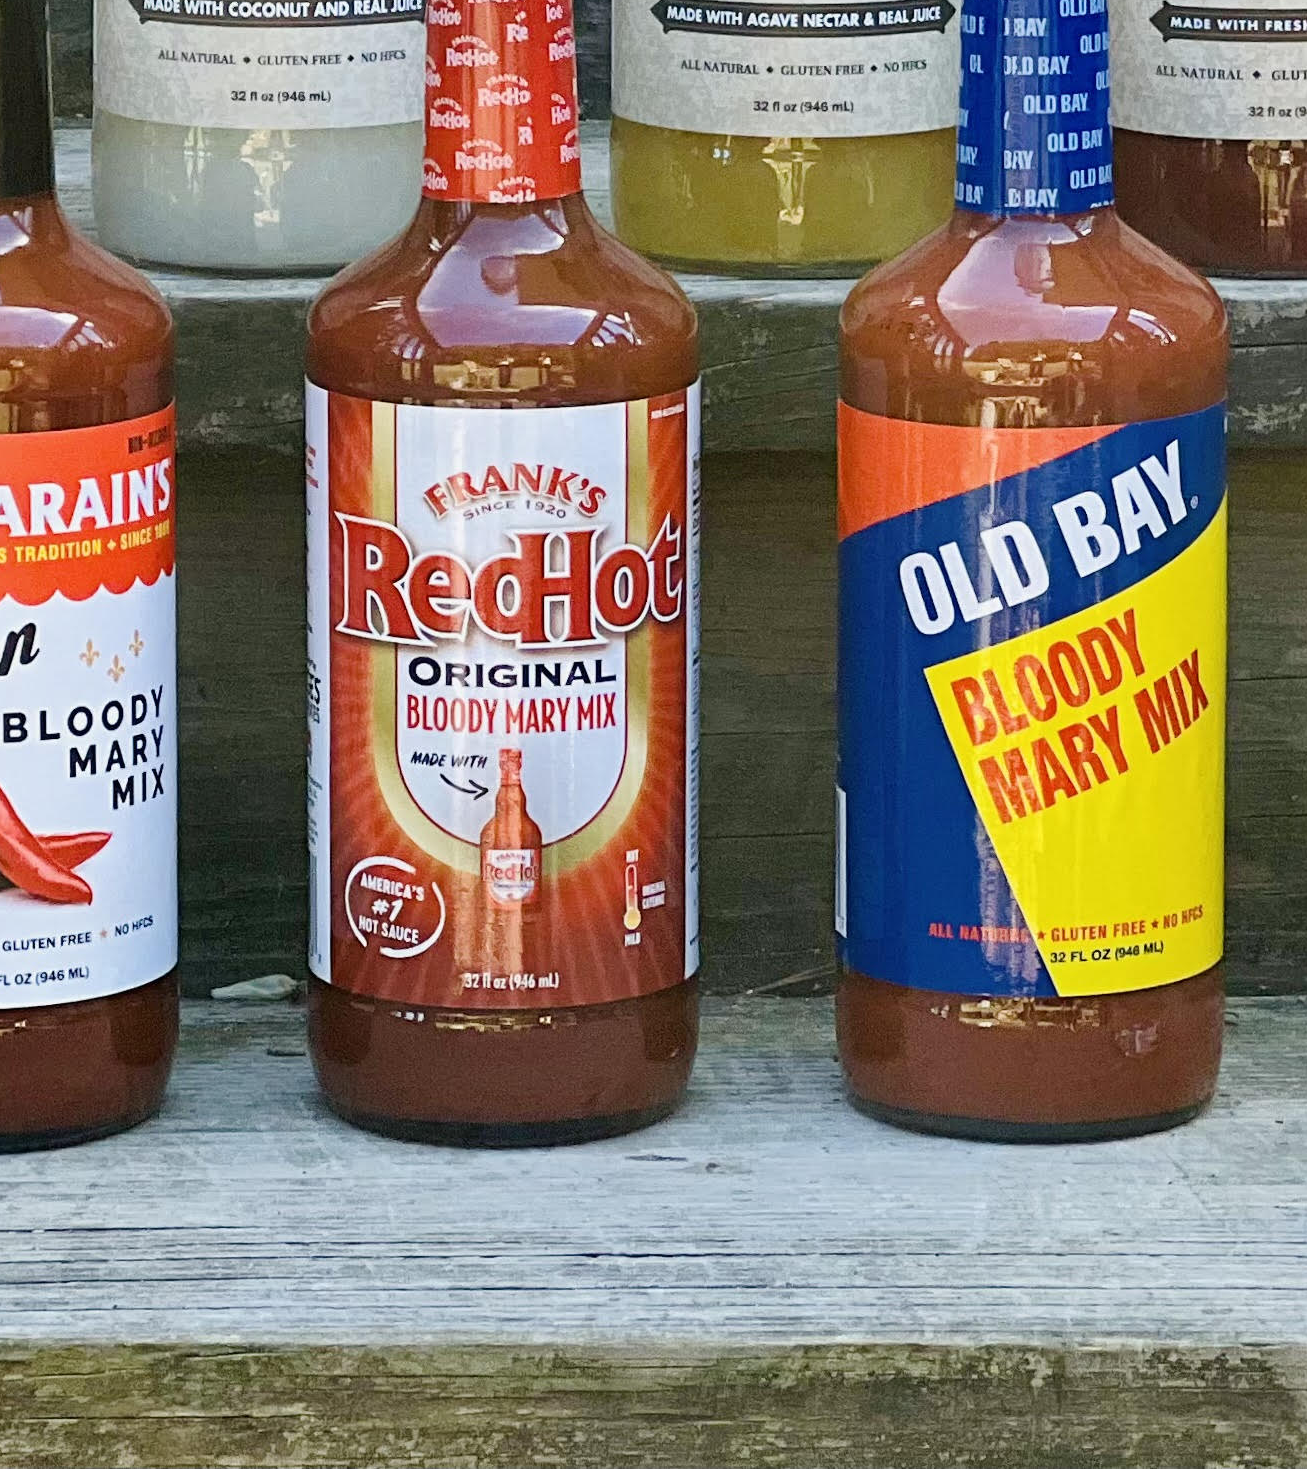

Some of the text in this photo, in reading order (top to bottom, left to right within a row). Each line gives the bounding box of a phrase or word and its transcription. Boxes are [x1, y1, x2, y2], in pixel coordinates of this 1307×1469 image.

[184, 0, 224, 16] WITH
[228, 1, 310, 18] COCONUT
[314, 0, 350, 17] AND
[1170, 16, 1211, 29] MADE
[1217, 19, 1258, 31] WITH
[1156, 65, 1176, 77] ALL
[1181, 67, 1243, 80] NATURAL
[1023, 93, 1088, 113] OLD BAY
[423, 463, 607, 520] FRANK'S
[463, 500, 566, 520] SINCE 1920
[14, 539, 101, 563] TRADITION
[120, 528, 151, 550] SINCE
[335, 511, 686, 649] RedHot
[898, 520, 1052, 635] OLD
[408, 656, 617, 689] ORIGINAL
[950, 609, 1145, 748] BLOODY
[2, 686, 164, 743] BLOODY
[407, 691, 617, 734] BLOODY MARY MIX
[69, 726, 164, 778] MARY
[978, 649, 1209, 824] MARY MIX
[410, 752, 487, 768] MADE WITH
[113, 779, 165, 810] MIX
[360, 873, 425, 901] AMERICA'S
[371, 899, 403, 922] #1
[2, 938, 56, 952] GLUTEN
[60, 932, 92, 947] FREE
[114, 923, 129, 936] NO
[132, 915, 154, 932] HFCS
[358, 916, 419, 944] HOT SAUCE
[1050, 952, 1066, 963] 32
[1071, 951, 1087, 961] FL
[1092, 949, 1110, 960] OZ
[1143, 940, 1164, 954] ML)
[14, 974, 32, 985] OZ
[35, 970, 65, 986] (946
[68, 967, 89, 979] ML)
